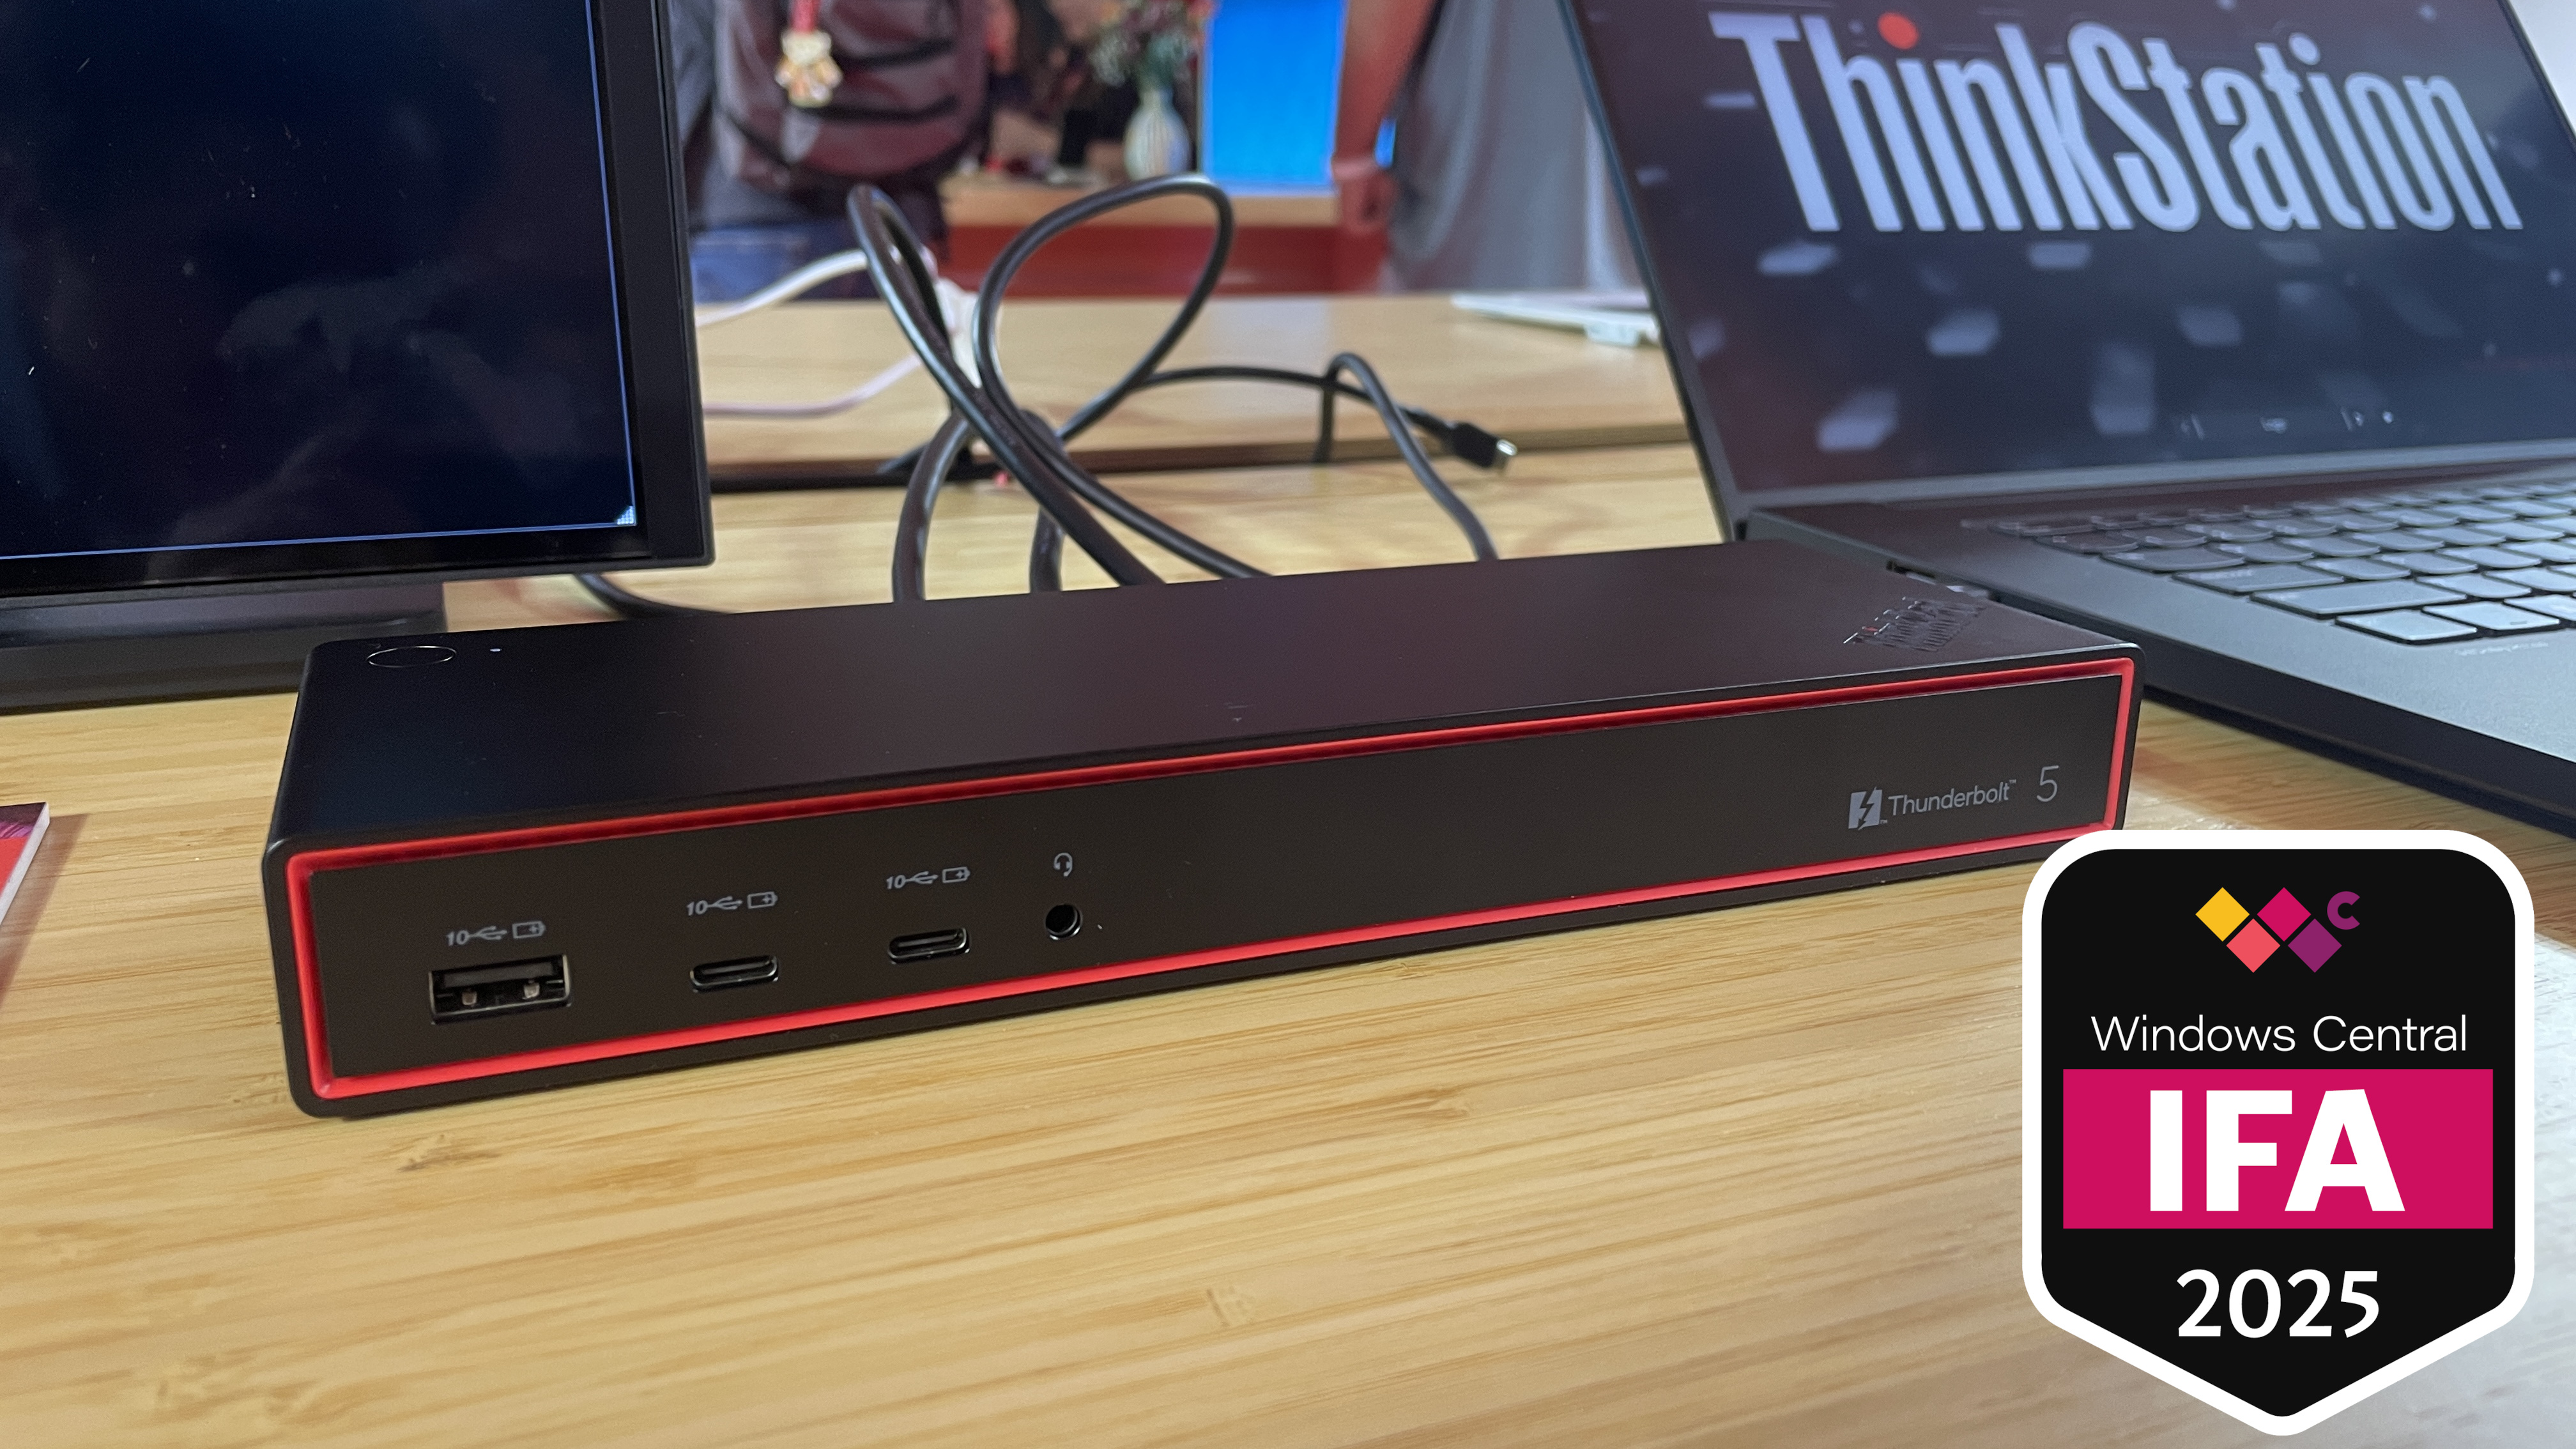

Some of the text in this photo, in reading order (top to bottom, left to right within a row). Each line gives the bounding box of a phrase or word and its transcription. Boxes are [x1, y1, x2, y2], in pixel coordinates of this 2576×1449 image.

[1711, 11, 2524, 231] ThinkStation
[2036, 765, 2059, 802] 5
[886, 875, 906, 889] 10
[687, 900, 709, 916] 10
[447, 930, 470, 946] 10
